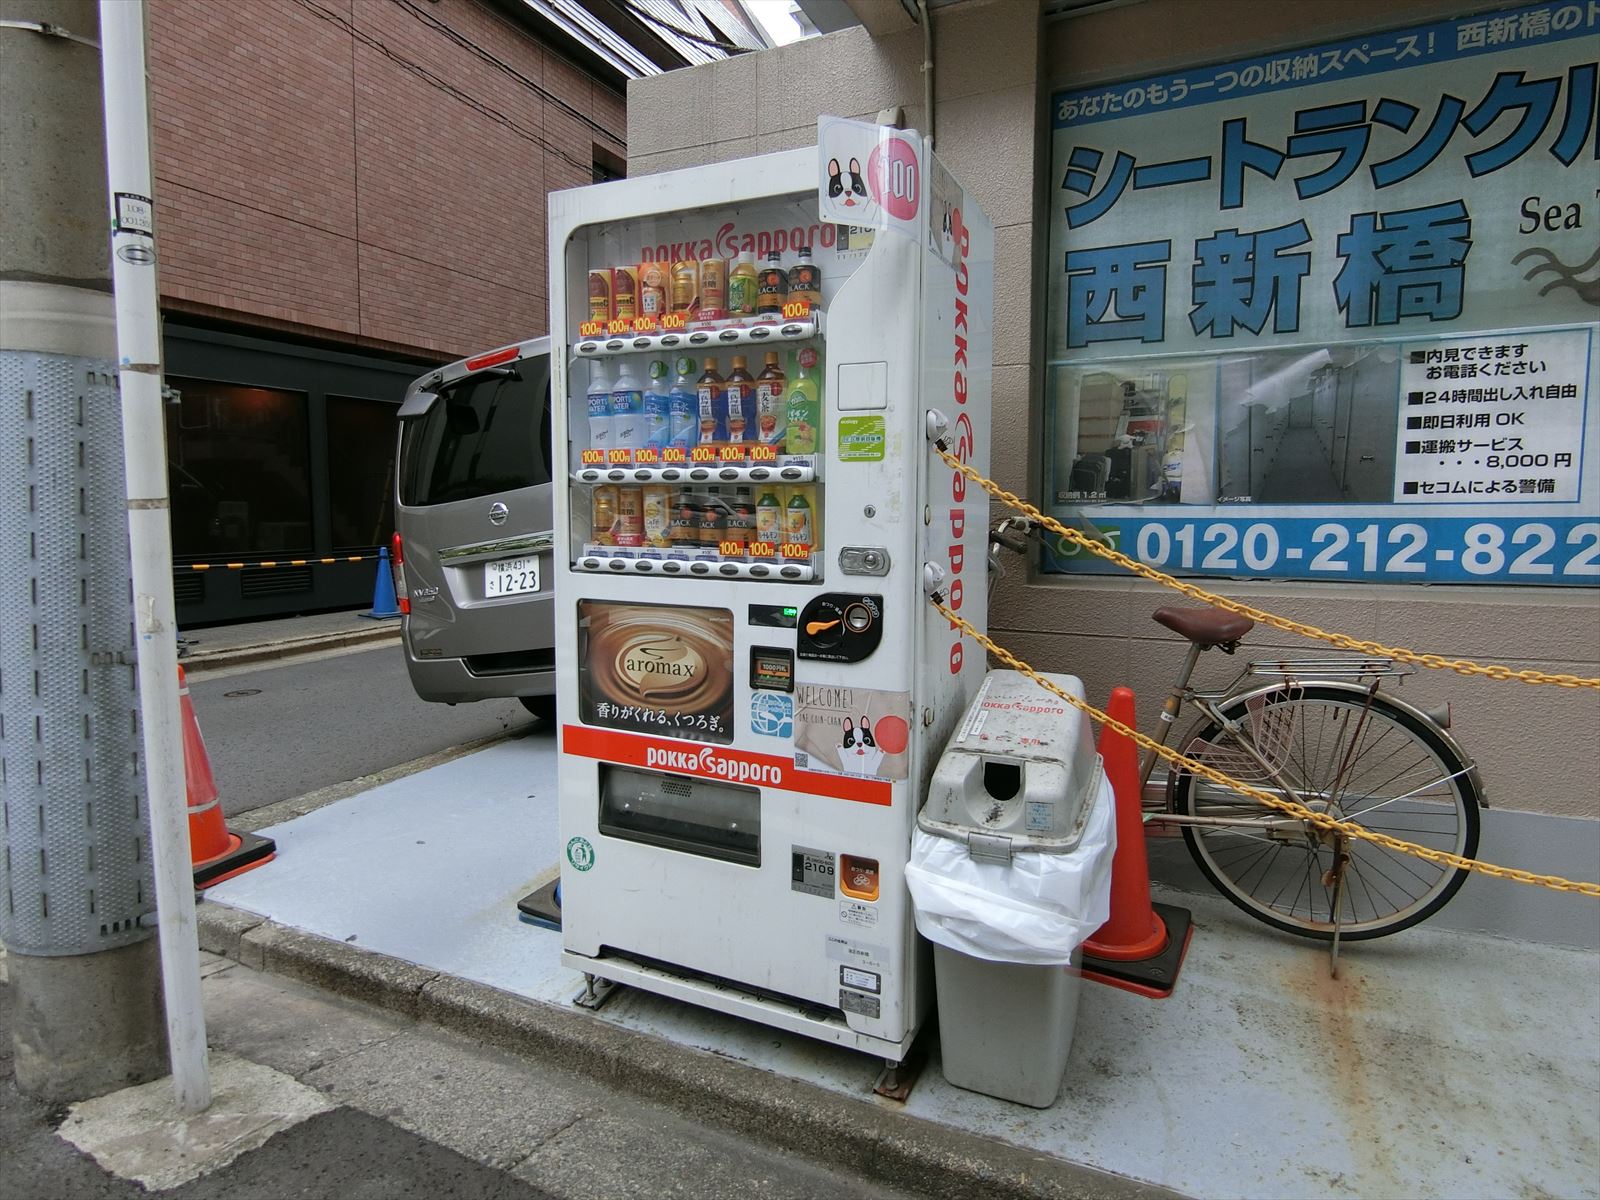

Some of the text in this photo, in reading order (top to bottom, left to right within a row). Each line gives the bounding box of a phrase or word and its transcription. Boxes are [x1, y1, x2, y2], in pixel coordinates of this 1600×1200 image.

[879, 156, 915, 204] 100
[1519, 196, 1582, 235] Sea
[1065, 198, 1473, 350] 西新橋
[758, 286, 777, 295] LACK
[783, 302, 809, 317] 100円
[608, 320, 629, 334] 100円
[633, 318, 656, 331] 100円
[662, 315, 685, 328] 100円
[581, 323, 602, 335] 100円
[1426, 344, 1529, 365] 内見できます
[1425, 360, 1546, 380] お電話ください
[1423, 412, 1526, 430] 即日利用 OK
[721, 447, 745, 459] 100円
[751, 447, 776, 459] 100円
[1421, 438, 1524, 455] 運搬サービス
[583, 450, 604, 463] 100円
[609, 450, 630, 463] 100円
[636, 450, 658, 462] 100円
[662, 449, 685, 462] 100円
[692, 448, 715, 460] 100円
[1419, 479, 1555, 495] セコムによる警備
[727, 520, 748, 528] LACK
[720, 542, 744, 555] 100円
[750, 542, 774, 556] 100円
[783, 543, 808, 557] 100円
[513, 559, 526, 571] 431
[499, 570, 536, 593] 12-23
[626, 658, 694, 677] aromax
[796, 686, 854, 709] WELCOME!
[596, 702, 724, 733] 香りがくれる、くつろぎ。
[805, 861, 834, 876] 2109
